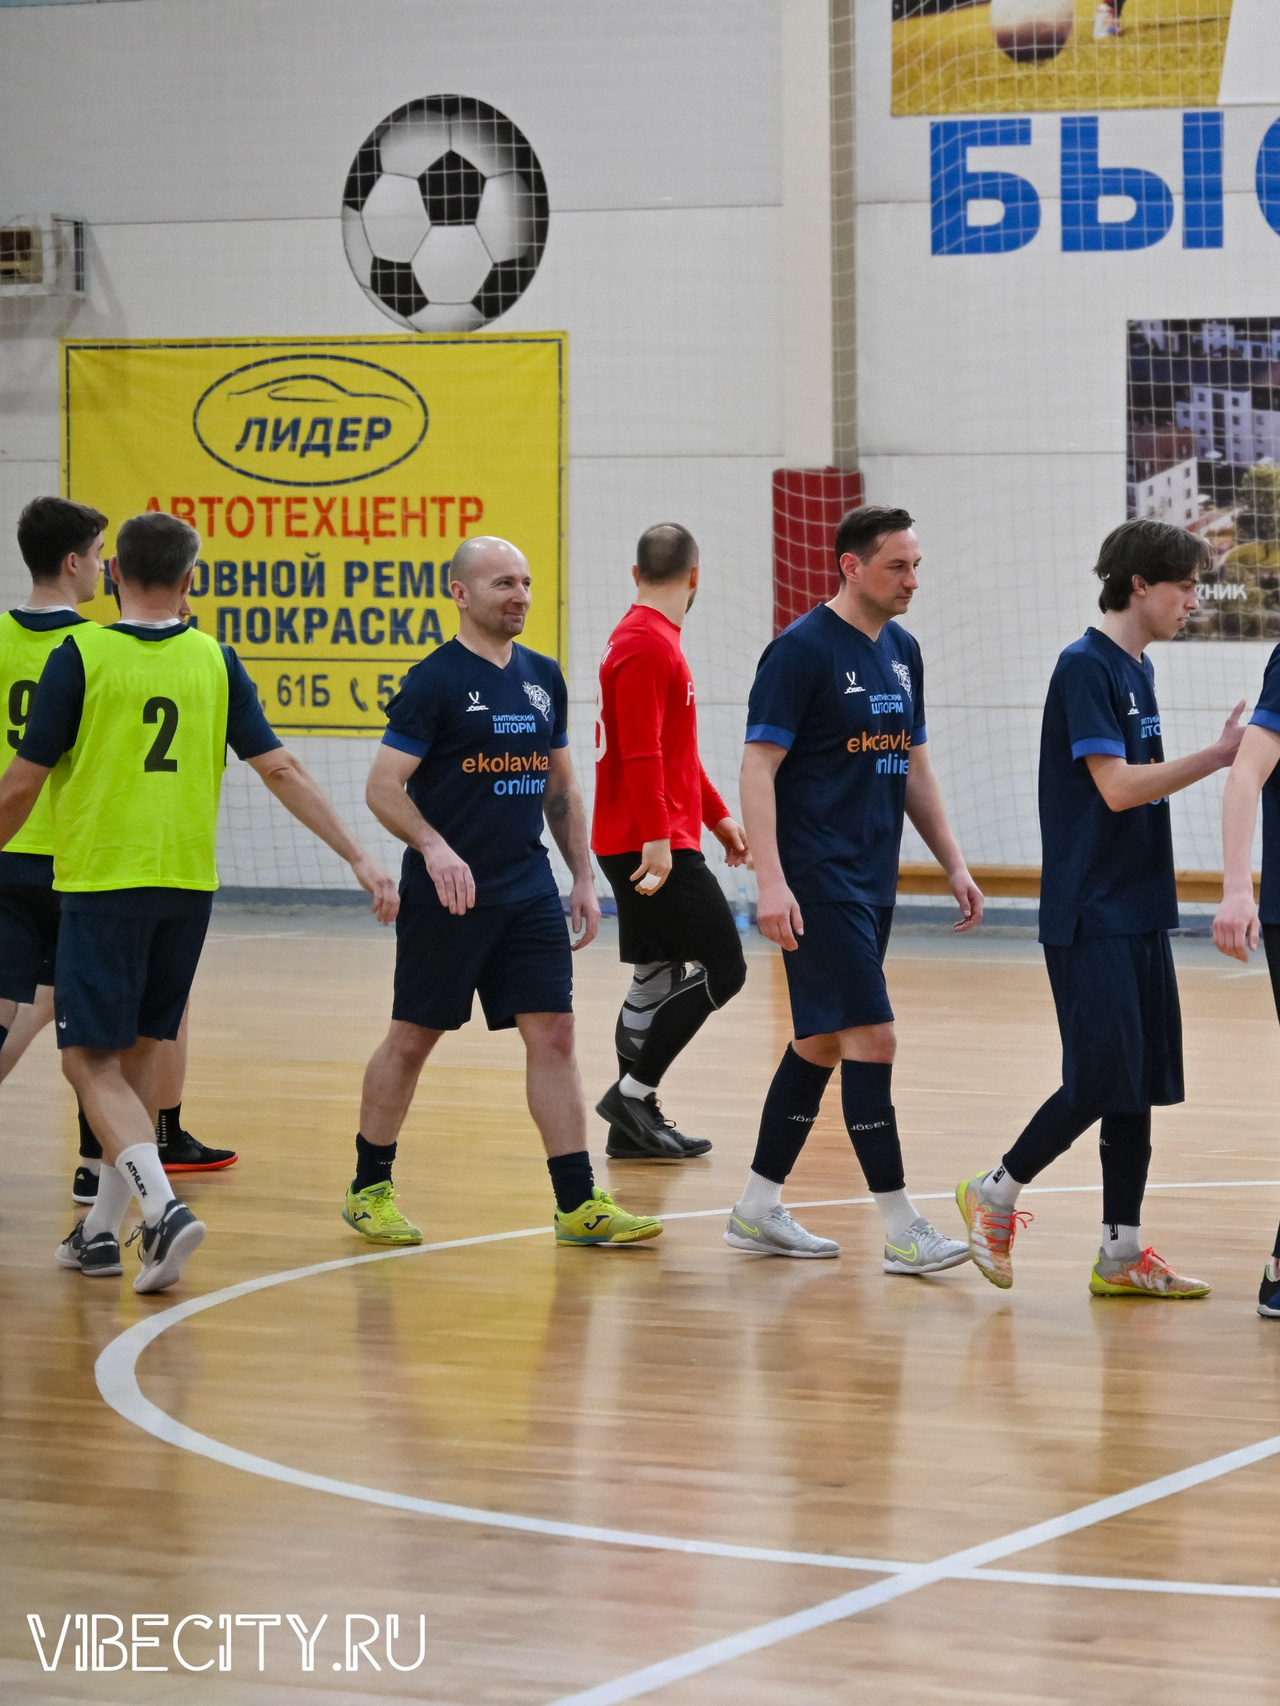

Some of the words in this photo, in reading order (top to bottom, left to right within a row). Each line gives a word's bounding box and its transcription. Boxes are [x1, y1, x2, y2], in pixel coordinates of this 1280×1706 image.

[235, 417, 392, 458] ЛИДЕР
[216, 607, 444, 646] ПОКРАСКА
[492, 714, 535, 722] БАЛТИЙСКИЙ
[494, 722, 537, 734] ШТОРМ
[143, 697, 179, 772] 2
[850, 1120, 891, 1132] JÖGEL
